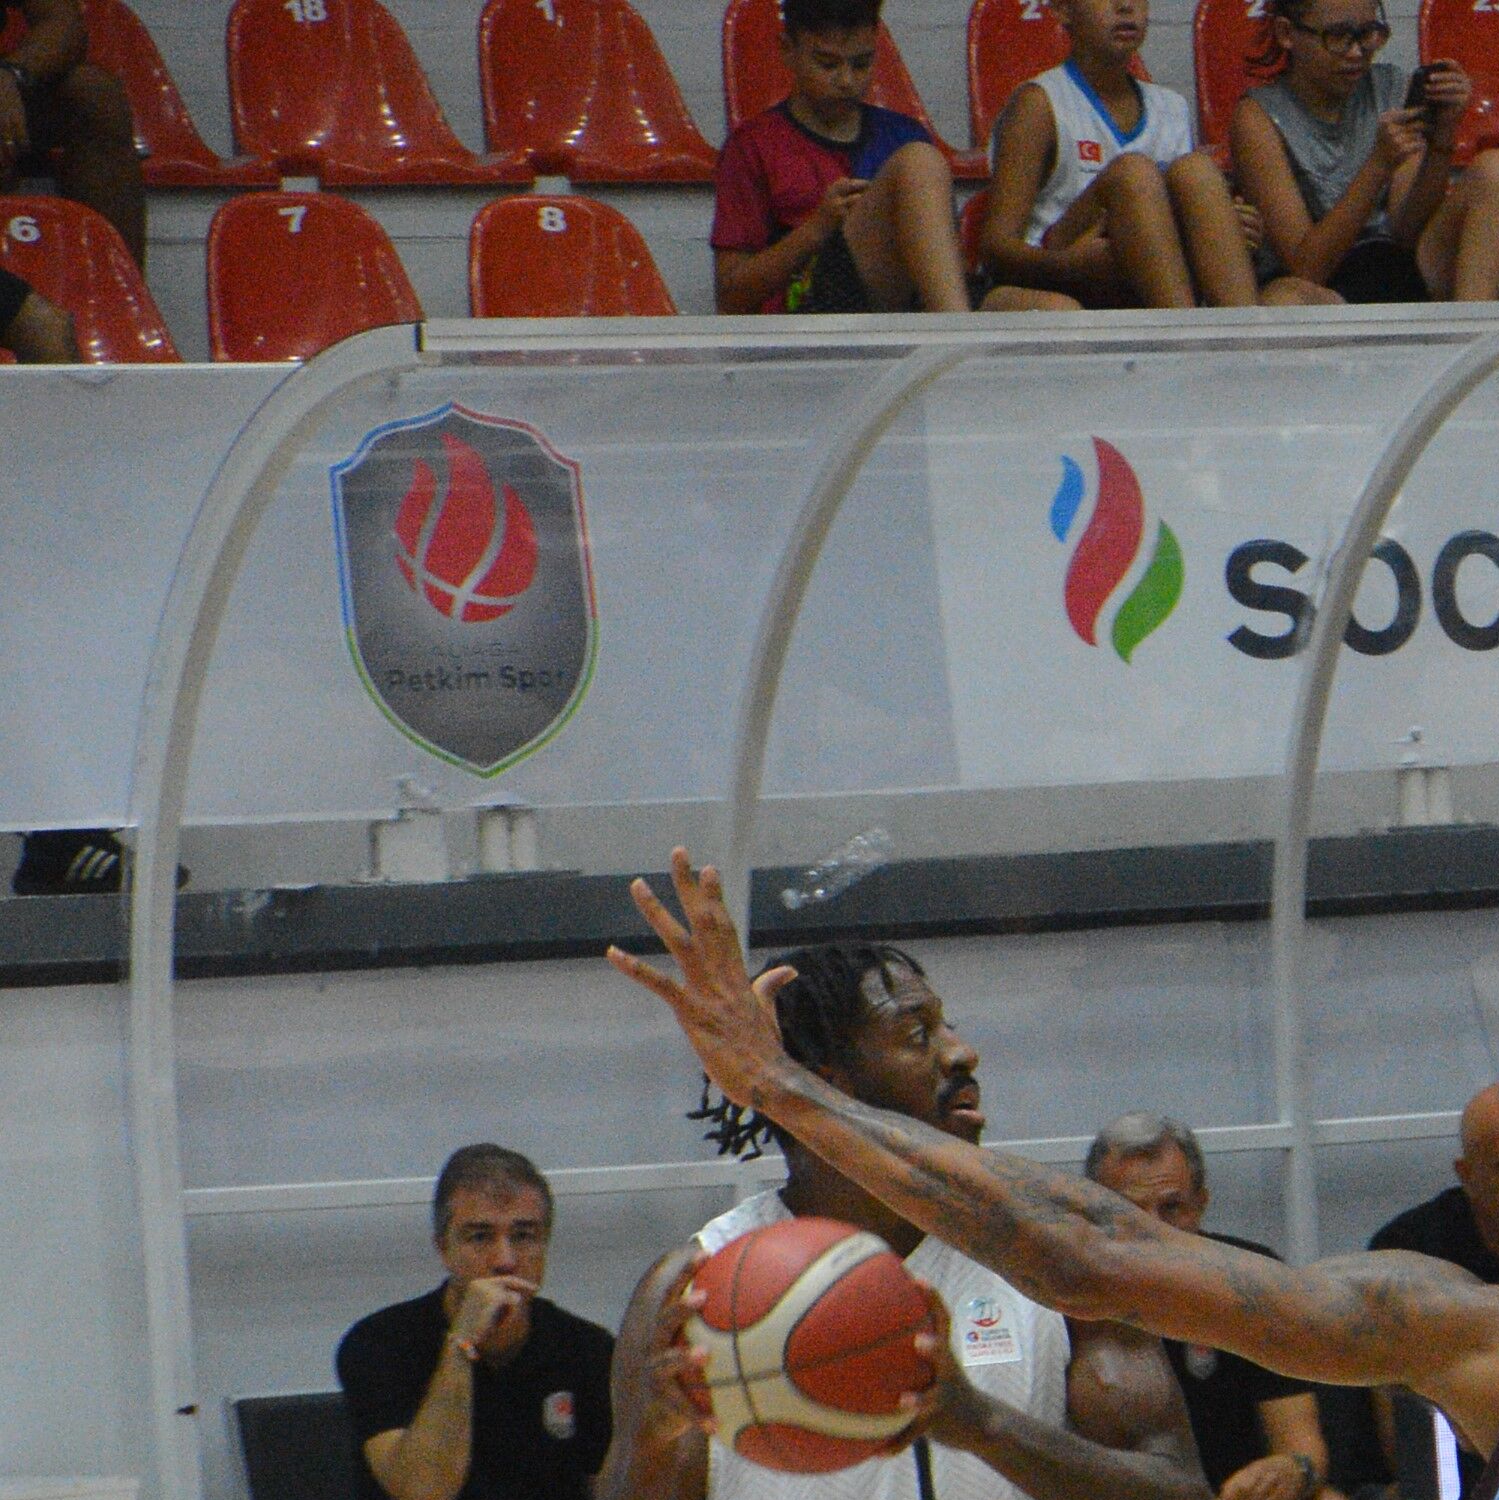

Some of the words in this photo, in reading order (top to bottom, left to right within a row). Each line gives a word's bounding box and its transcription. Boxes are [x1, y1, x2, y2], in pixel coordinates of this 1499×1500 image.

[9, 216, 40, 243] 6
[278, 206, 308, 233] 7
[537, 206, 567, 232] 8
